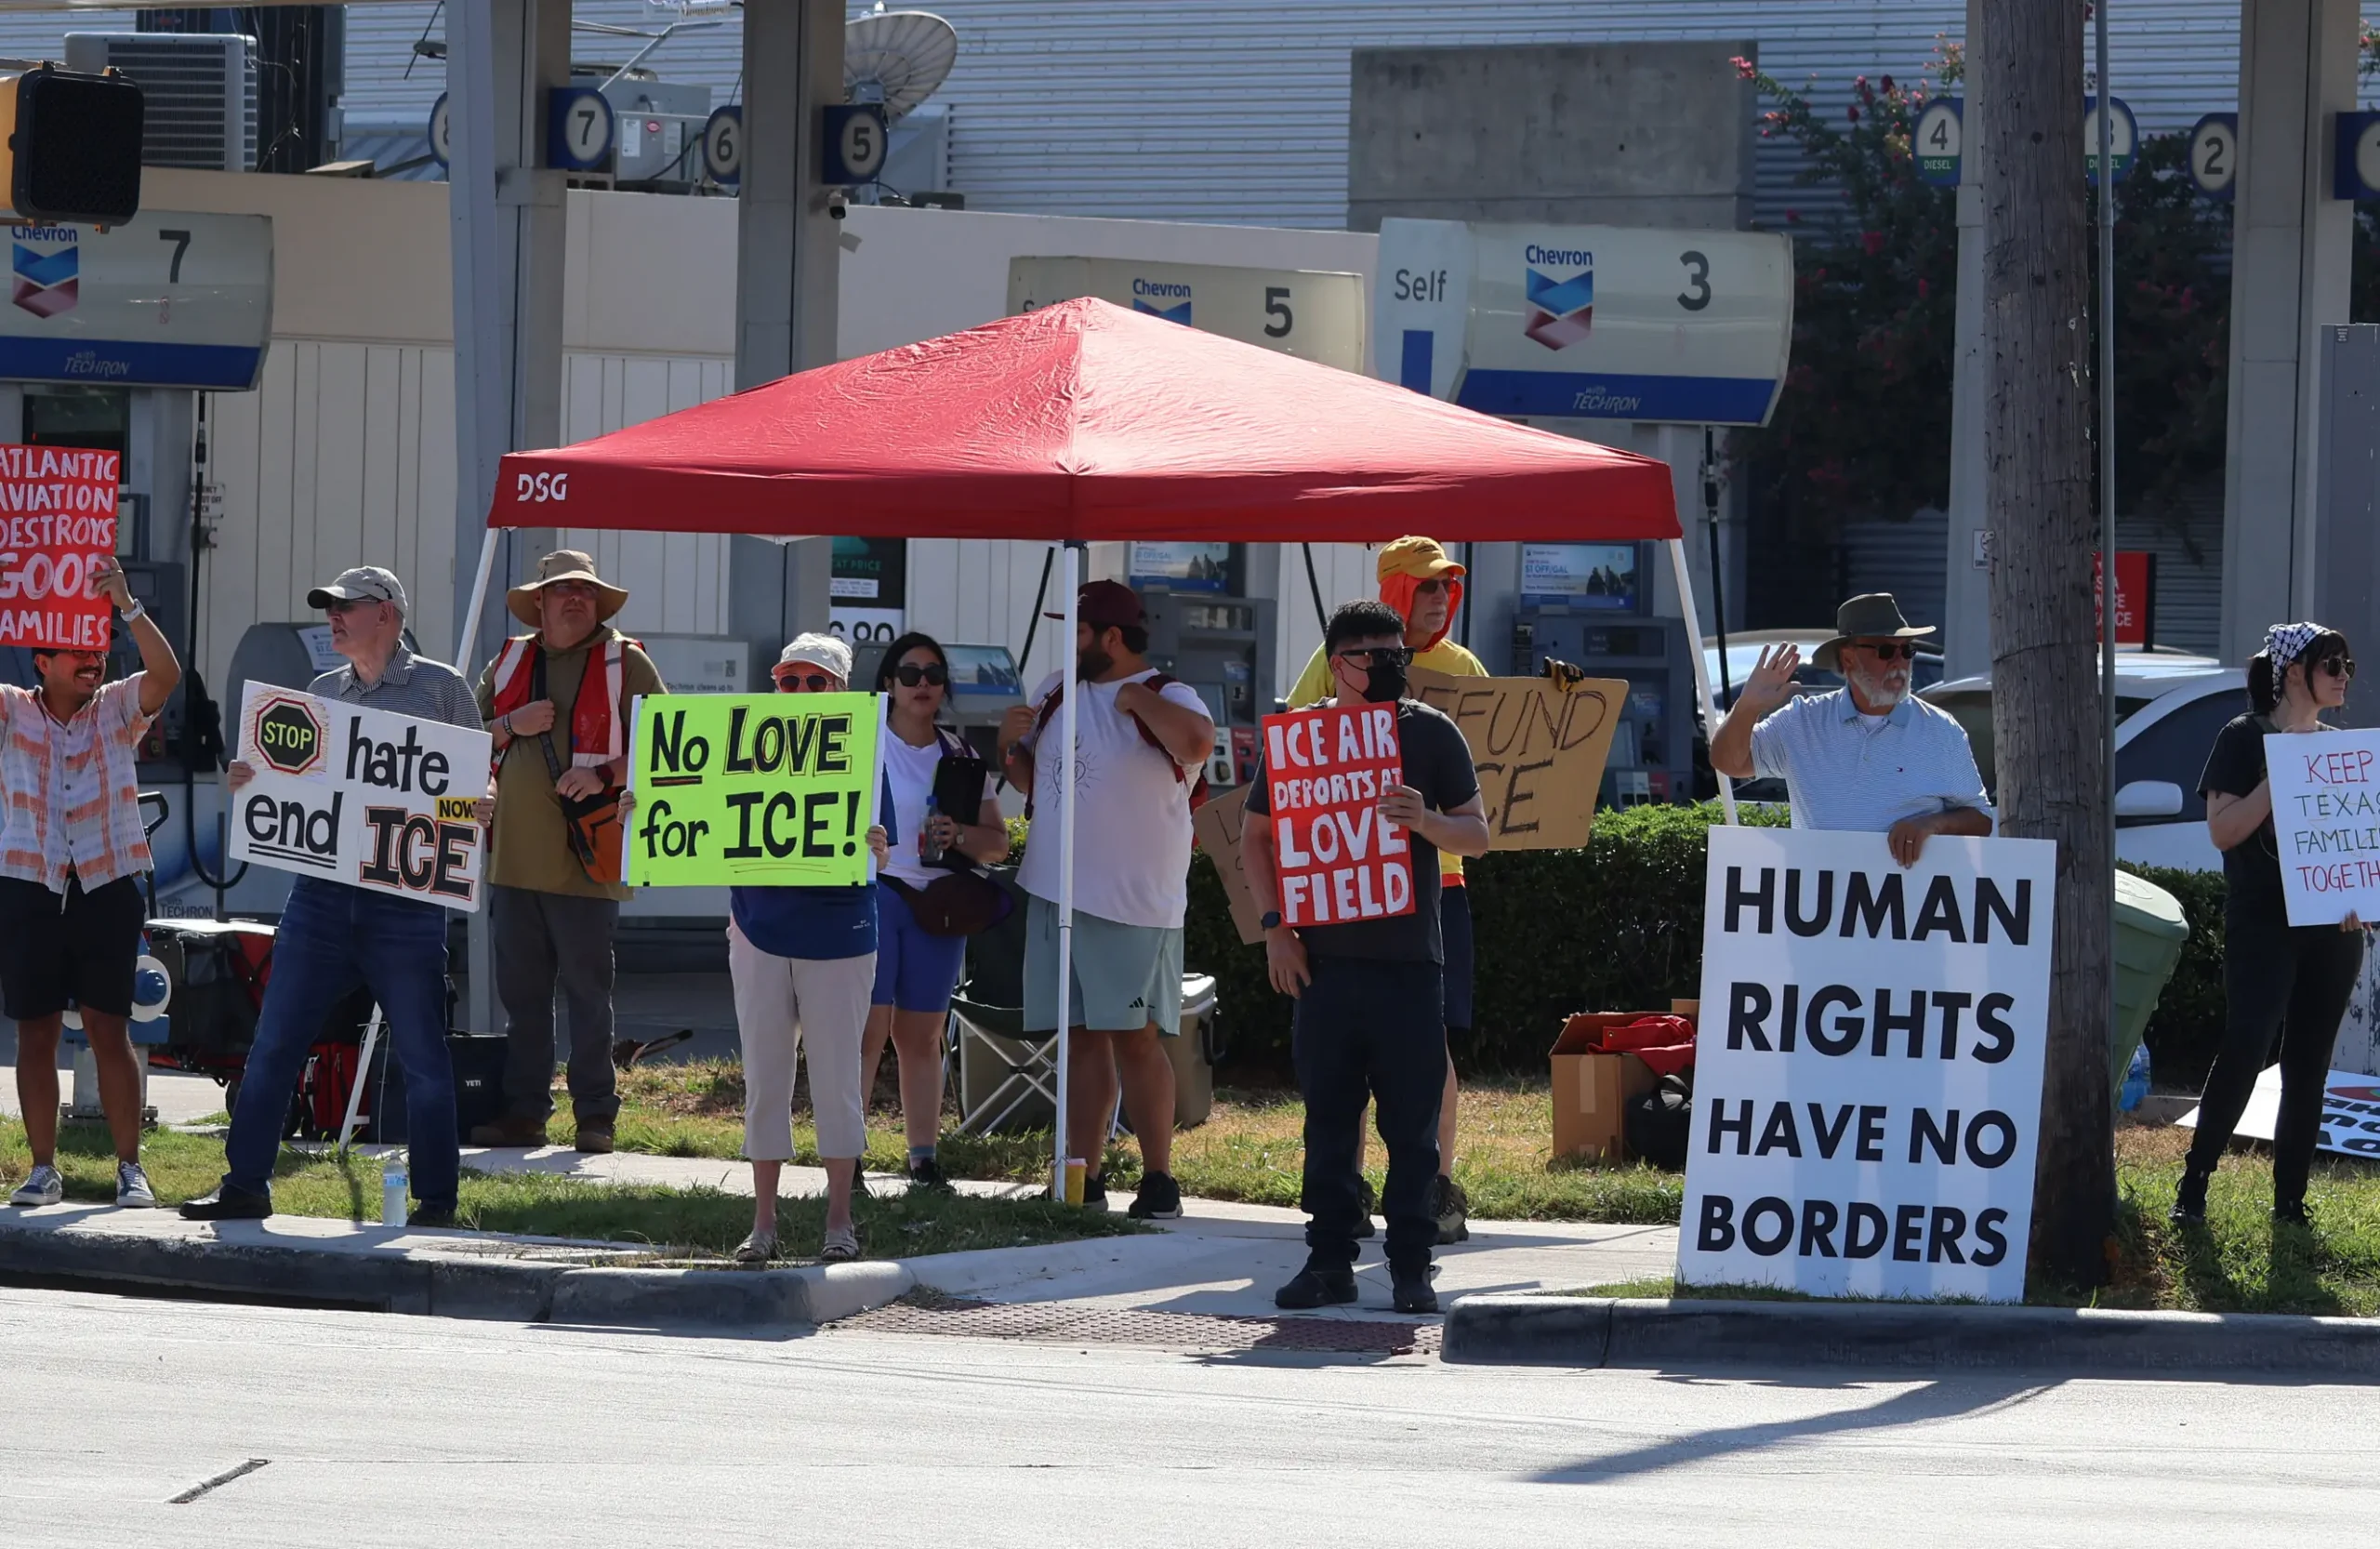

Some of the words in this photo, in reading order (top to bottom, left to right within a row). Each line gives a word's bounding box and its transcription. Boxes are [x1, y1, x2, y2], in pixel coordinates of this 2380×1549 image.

[577, 110, 596, 146] 7
[716, 126, 734, 162] 6
[852, 126, 871, 163] 5
[1929, 118, 1949, 151] 4
[1924, 159, 1952, 171] DIESEL
[2088, 159, 2121, 169] DIEL
[2204, 137, 2224, 175] 2
[11, 224, 78, 243] Chevron
[159, 229, 192, 284] 7
[1525, 244, 1593, 267] Chevron
[1132, 278, 1192, 298] Chevron
[1394, 268, 1448, 303] Self
[1676, 250, 1712, 311] 3
[1263, 286, 1293, 338] 5
[64, 356, 130, 377] TECHRON
[1572, 391, 1641, 414] TECHRON
[517, 471, 568, 502] DSG
[0, 609, 110, 647] AMILIES
[264, 721, 313, 750] STOP
[345, 715, 450, 797] hate
[650, 710, 709, 773] No
[722, 705, 853, 777] LOVE
[1267, 718, 1329, 770] ICE
[1338, 709, 1396, 763] AIR
[2302, 749, 2373, 784] KEEP
[1274, 769, 1376, 811] DEPORTS
[439, 799, 476, 819] NOW
[640, 800, 709, 859] for
[723, 790, 862, 859] ICE!
[245, 791, 344, 855] end
[359, 805, 479, 901] ICE
[1277, 804, 1408, 868] LOVE
[2294, 827, 2380, 854] FAMILI
[1283, 862, 1409, 923] FIELD
[2295, 859, 2380, 893] TOGETH
[160, 905, 214, 919] TECHRON
[1723, 866, 2031, 946] HUMAN
[1726, 981, 2016, 1064] RIGHTS
[1707, 1098, 1887, 1162] HAVE
[1908, 1107, 2017, 1169] NO
[1697, 1194, 2009, 1267] BORDERS
